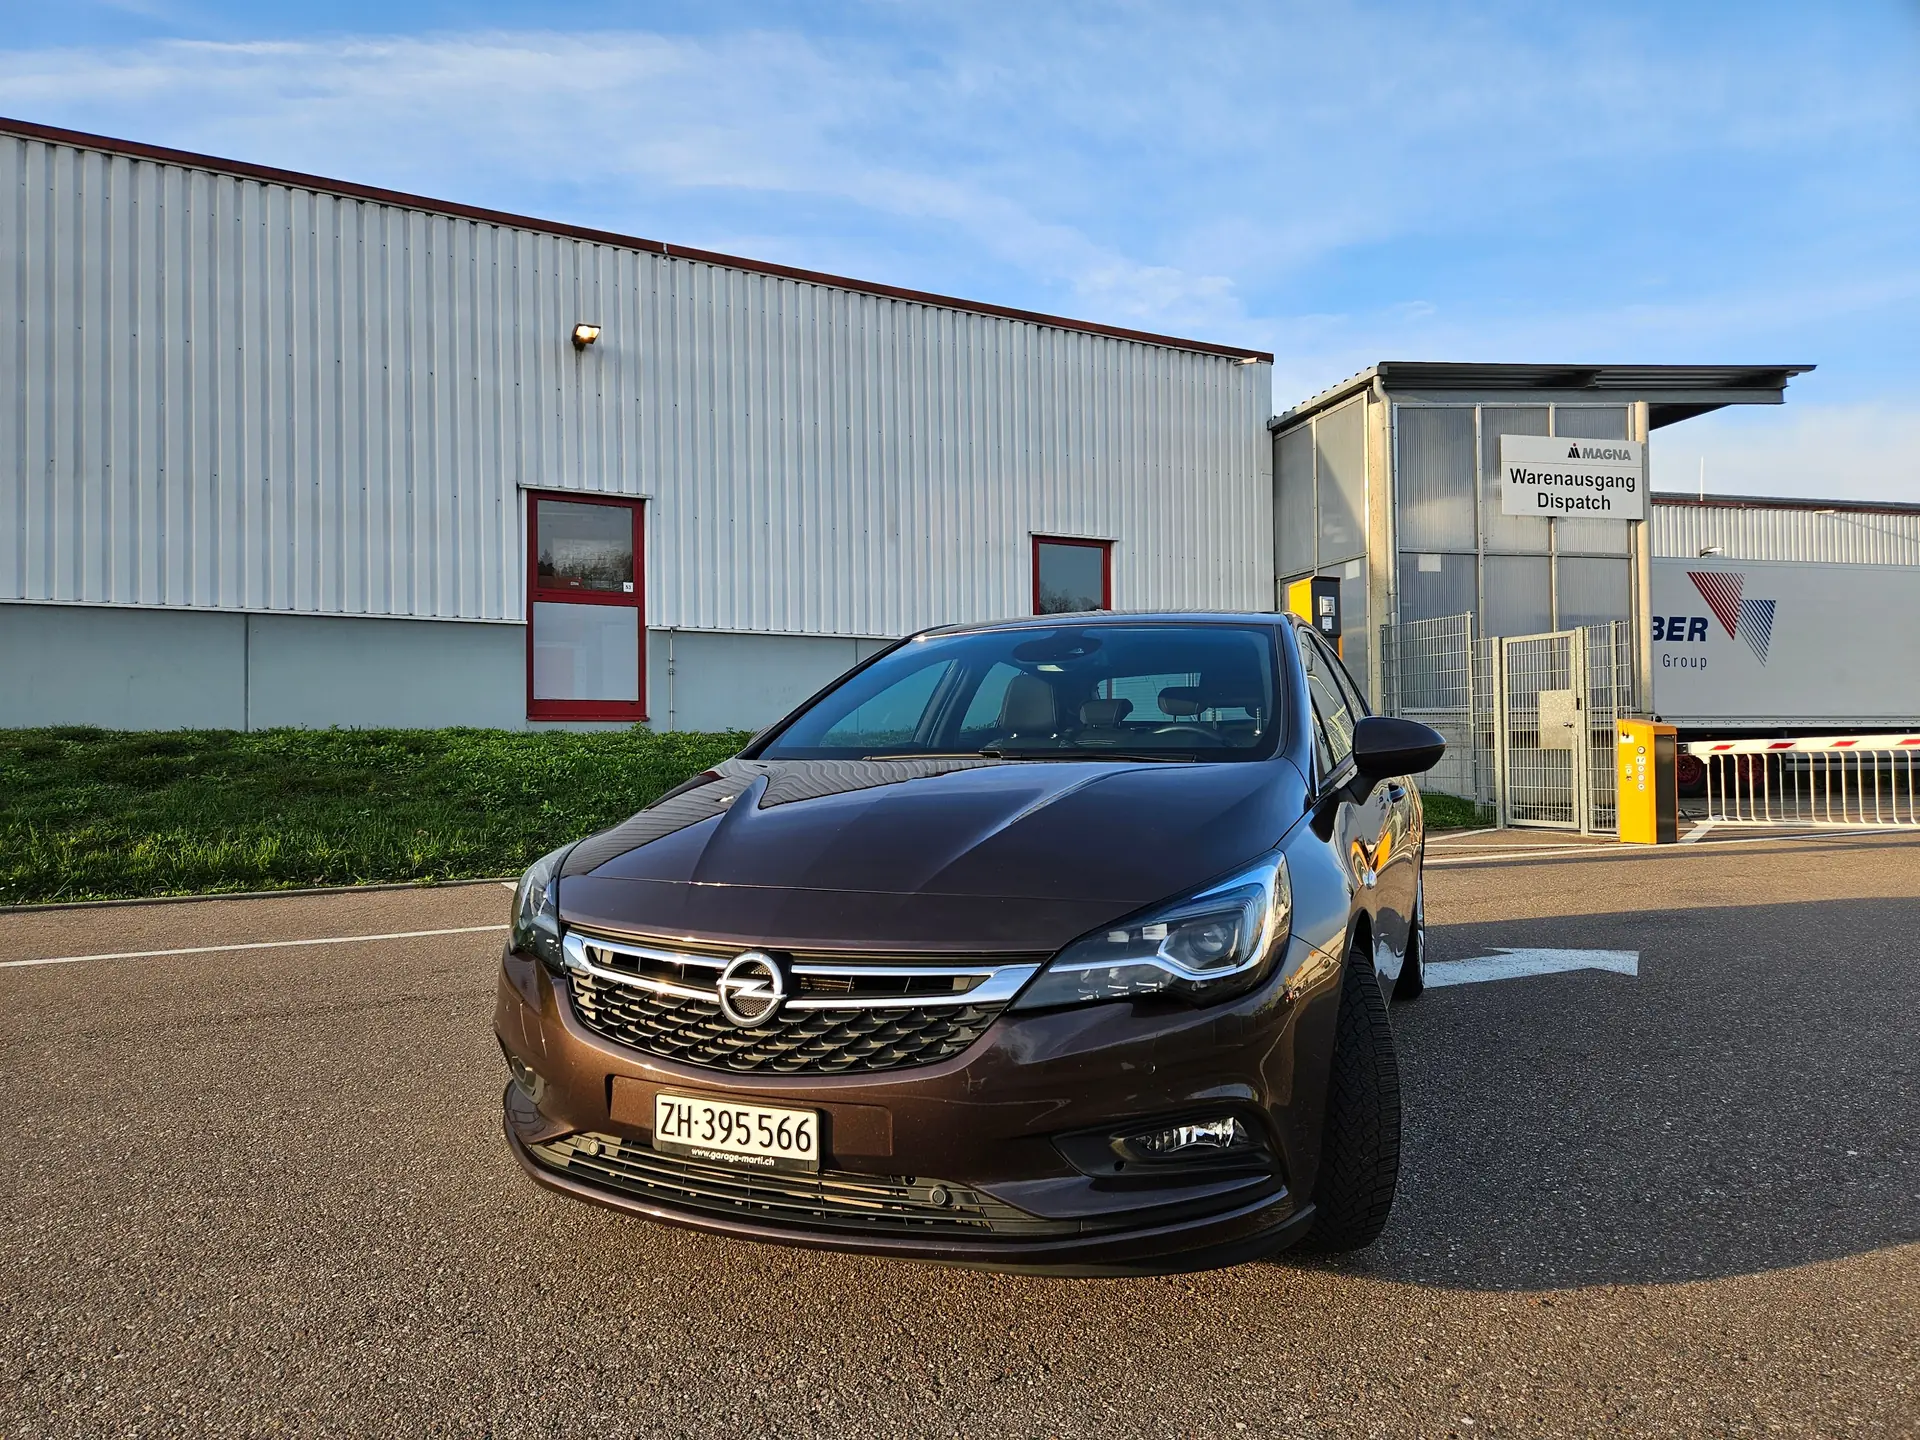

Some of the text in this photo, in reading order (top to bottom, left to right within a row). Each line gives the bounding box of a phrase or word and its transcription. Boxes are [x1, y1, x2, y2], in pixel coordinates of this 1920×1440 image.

[1582, 447, 1632, 461] MAGNA
[1510, 468, 1635, 492] Warenausgang
[1537, 492, 1611, 512] Dispatch
[1662, 653, 1707, 671] Group
[691, 1148, 775, 1166] www.garage-marti.ch
